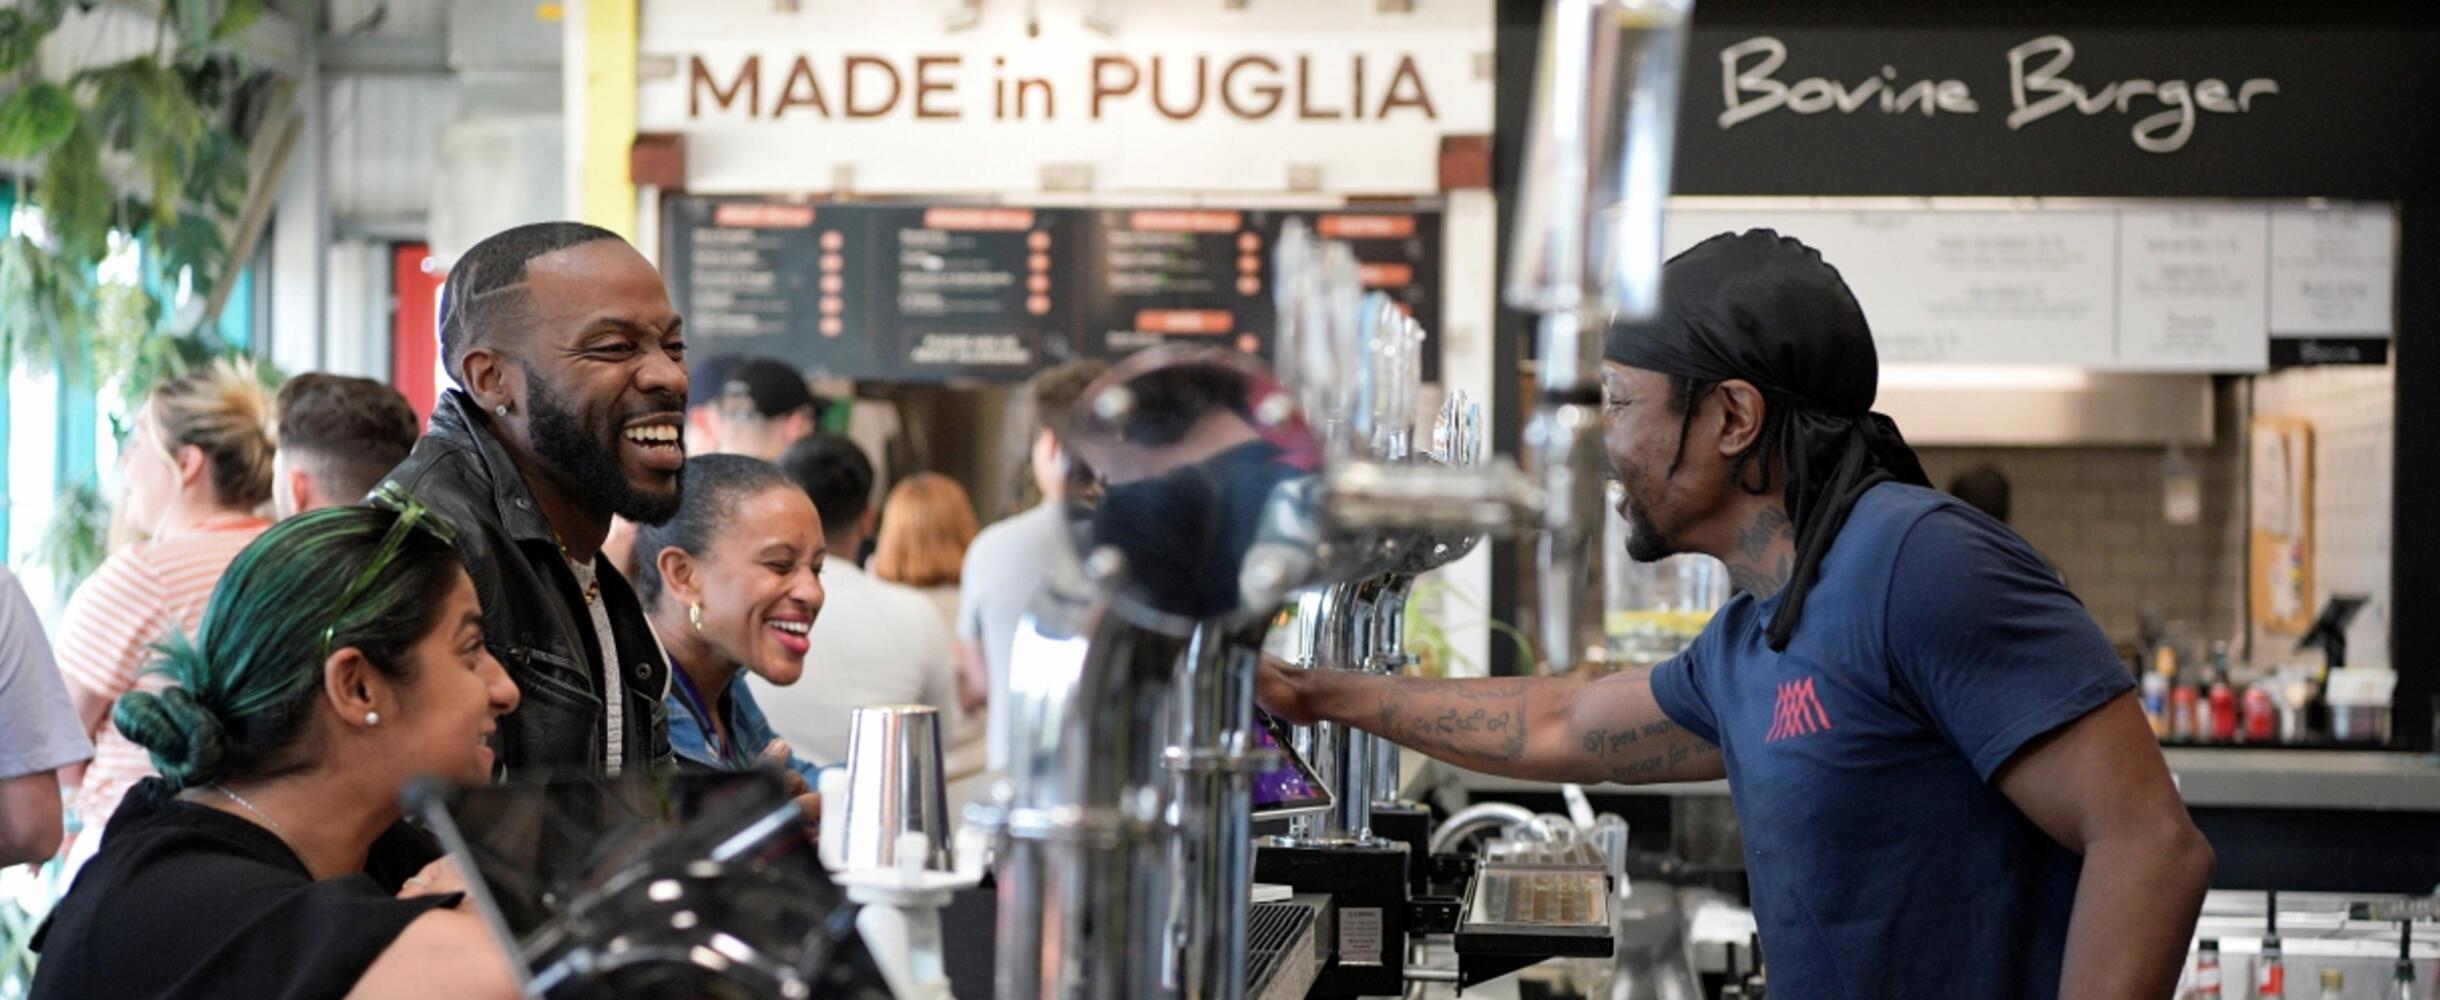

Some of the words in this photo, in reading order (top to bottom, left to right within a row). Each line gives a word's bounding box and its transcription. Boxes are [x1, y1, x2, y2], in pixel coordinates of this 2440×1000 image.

[688, 54, 962, 120] MADE
[994, 57, 1055, 120] in
[1090, 54, 1438, 121] PUGLIA
[1718, 36, 1979, 129] Bovine
[2008, 35, 2280, 153] Burger
